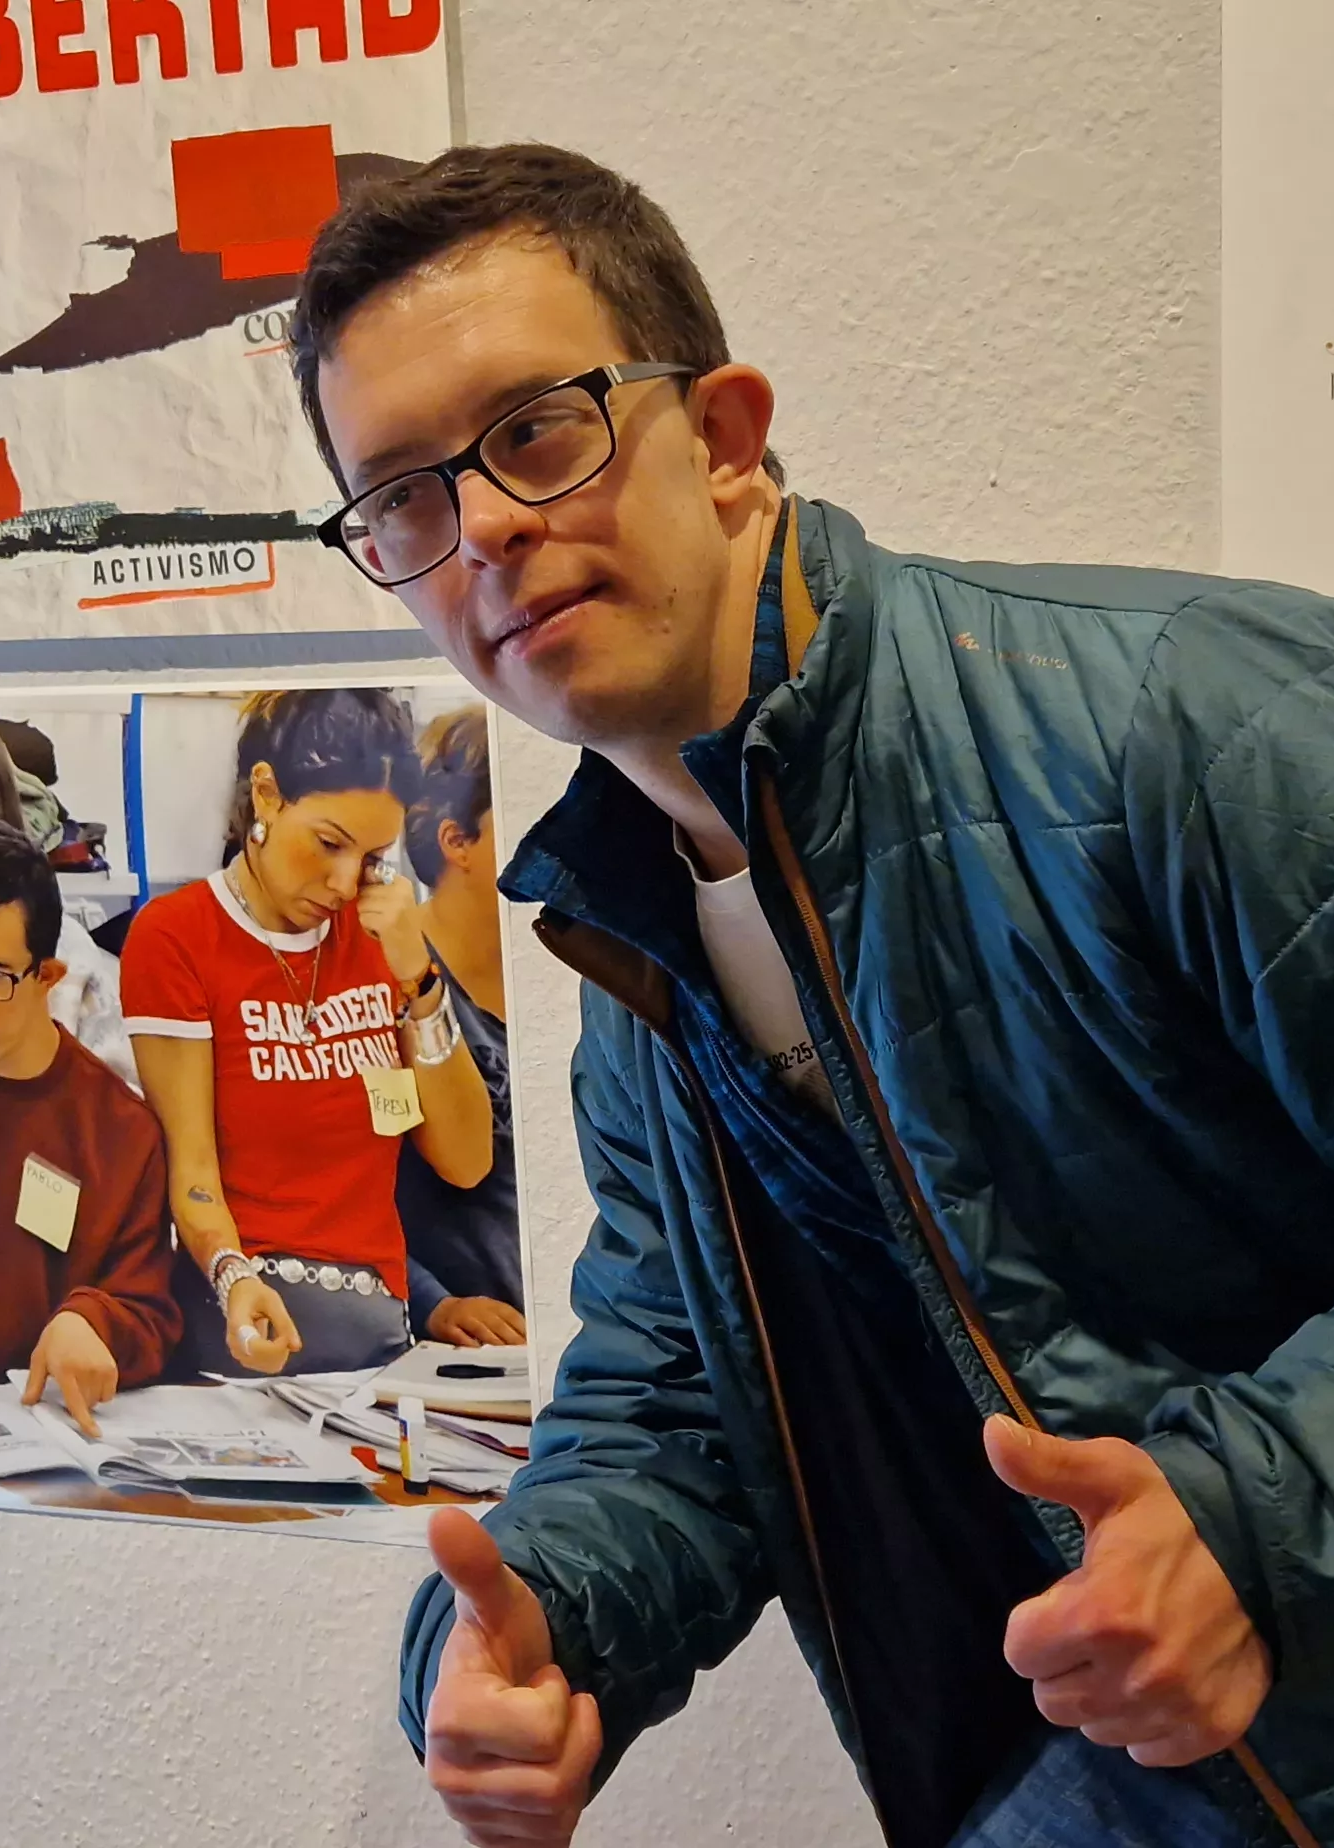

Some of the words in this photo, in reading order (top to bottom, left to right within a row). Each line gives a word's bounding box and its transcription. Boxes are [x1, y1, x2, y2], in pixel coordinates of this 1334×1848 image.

[92, 547, 256, 586] ACTIVISMO
[239, 999, 309, 1046] SAN
[314, 982, 395, 1040] DIEGO
